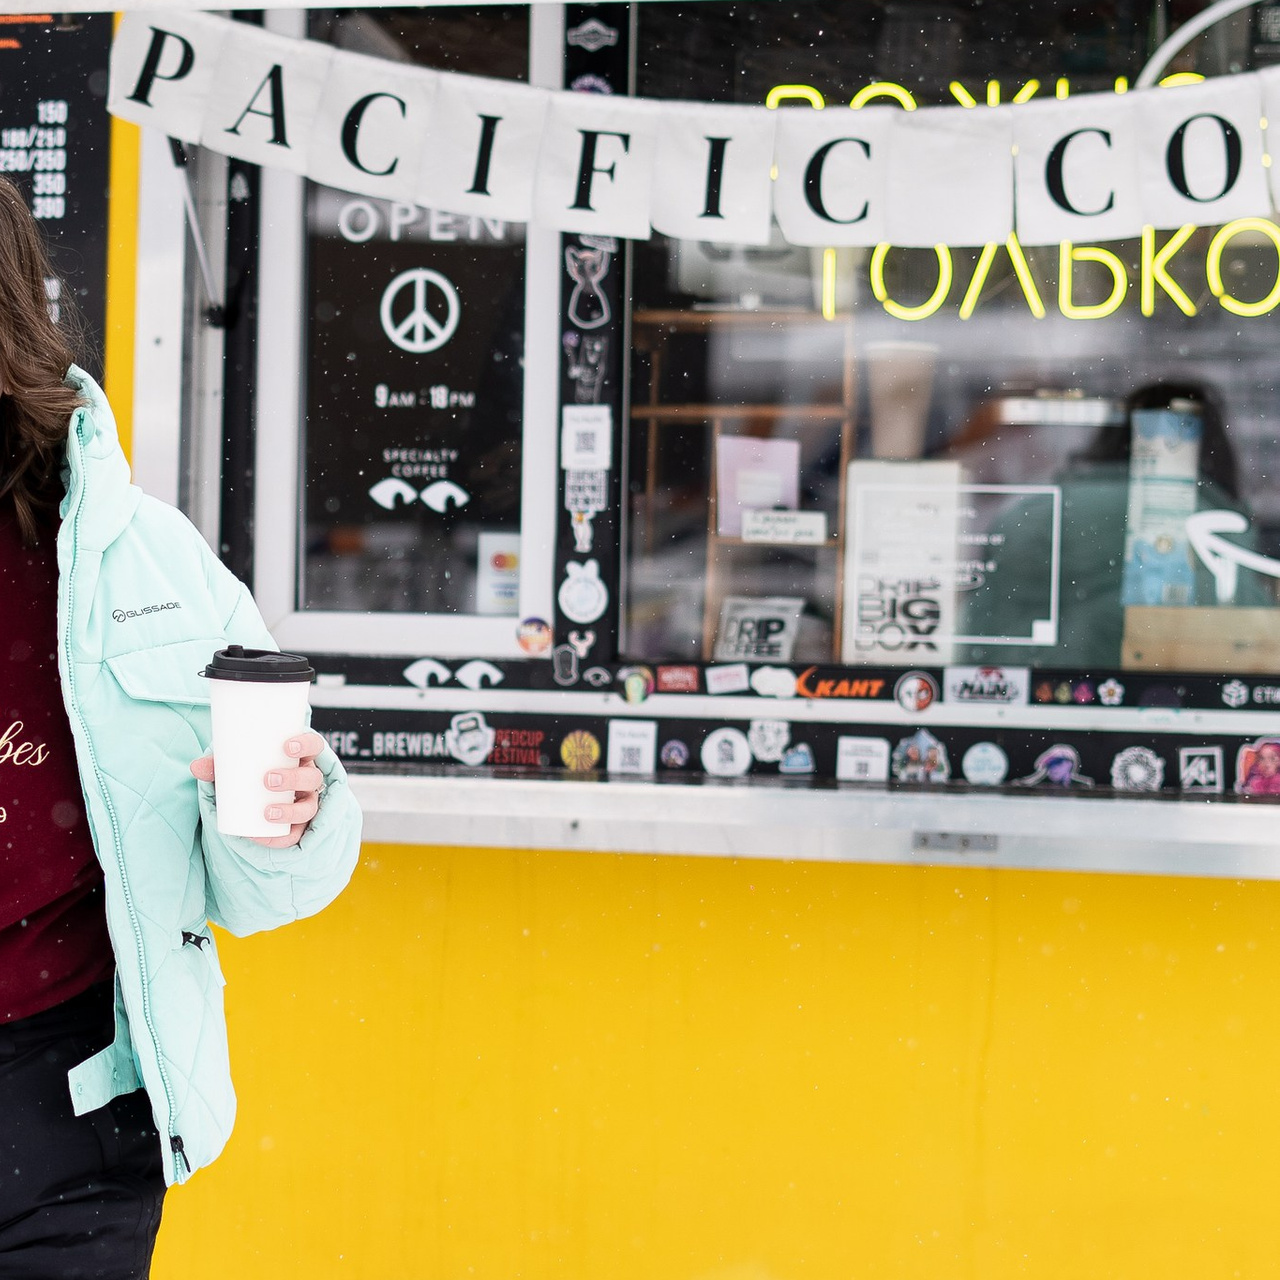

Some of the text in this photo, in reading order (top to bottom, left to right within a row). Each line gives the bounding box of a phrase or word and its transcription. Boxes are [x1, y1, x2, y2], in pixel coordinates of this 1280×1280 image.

[37, 100, 68, 124] 150
[125, 26, 871, 224] PACIFIC
[339, 200, 506, 242] OPEN
[382, 448, 459, 463] SPECIALTY
[391, 463, 448, 478] COFFEE
[126, 602, 182, 618] GLISSADE
